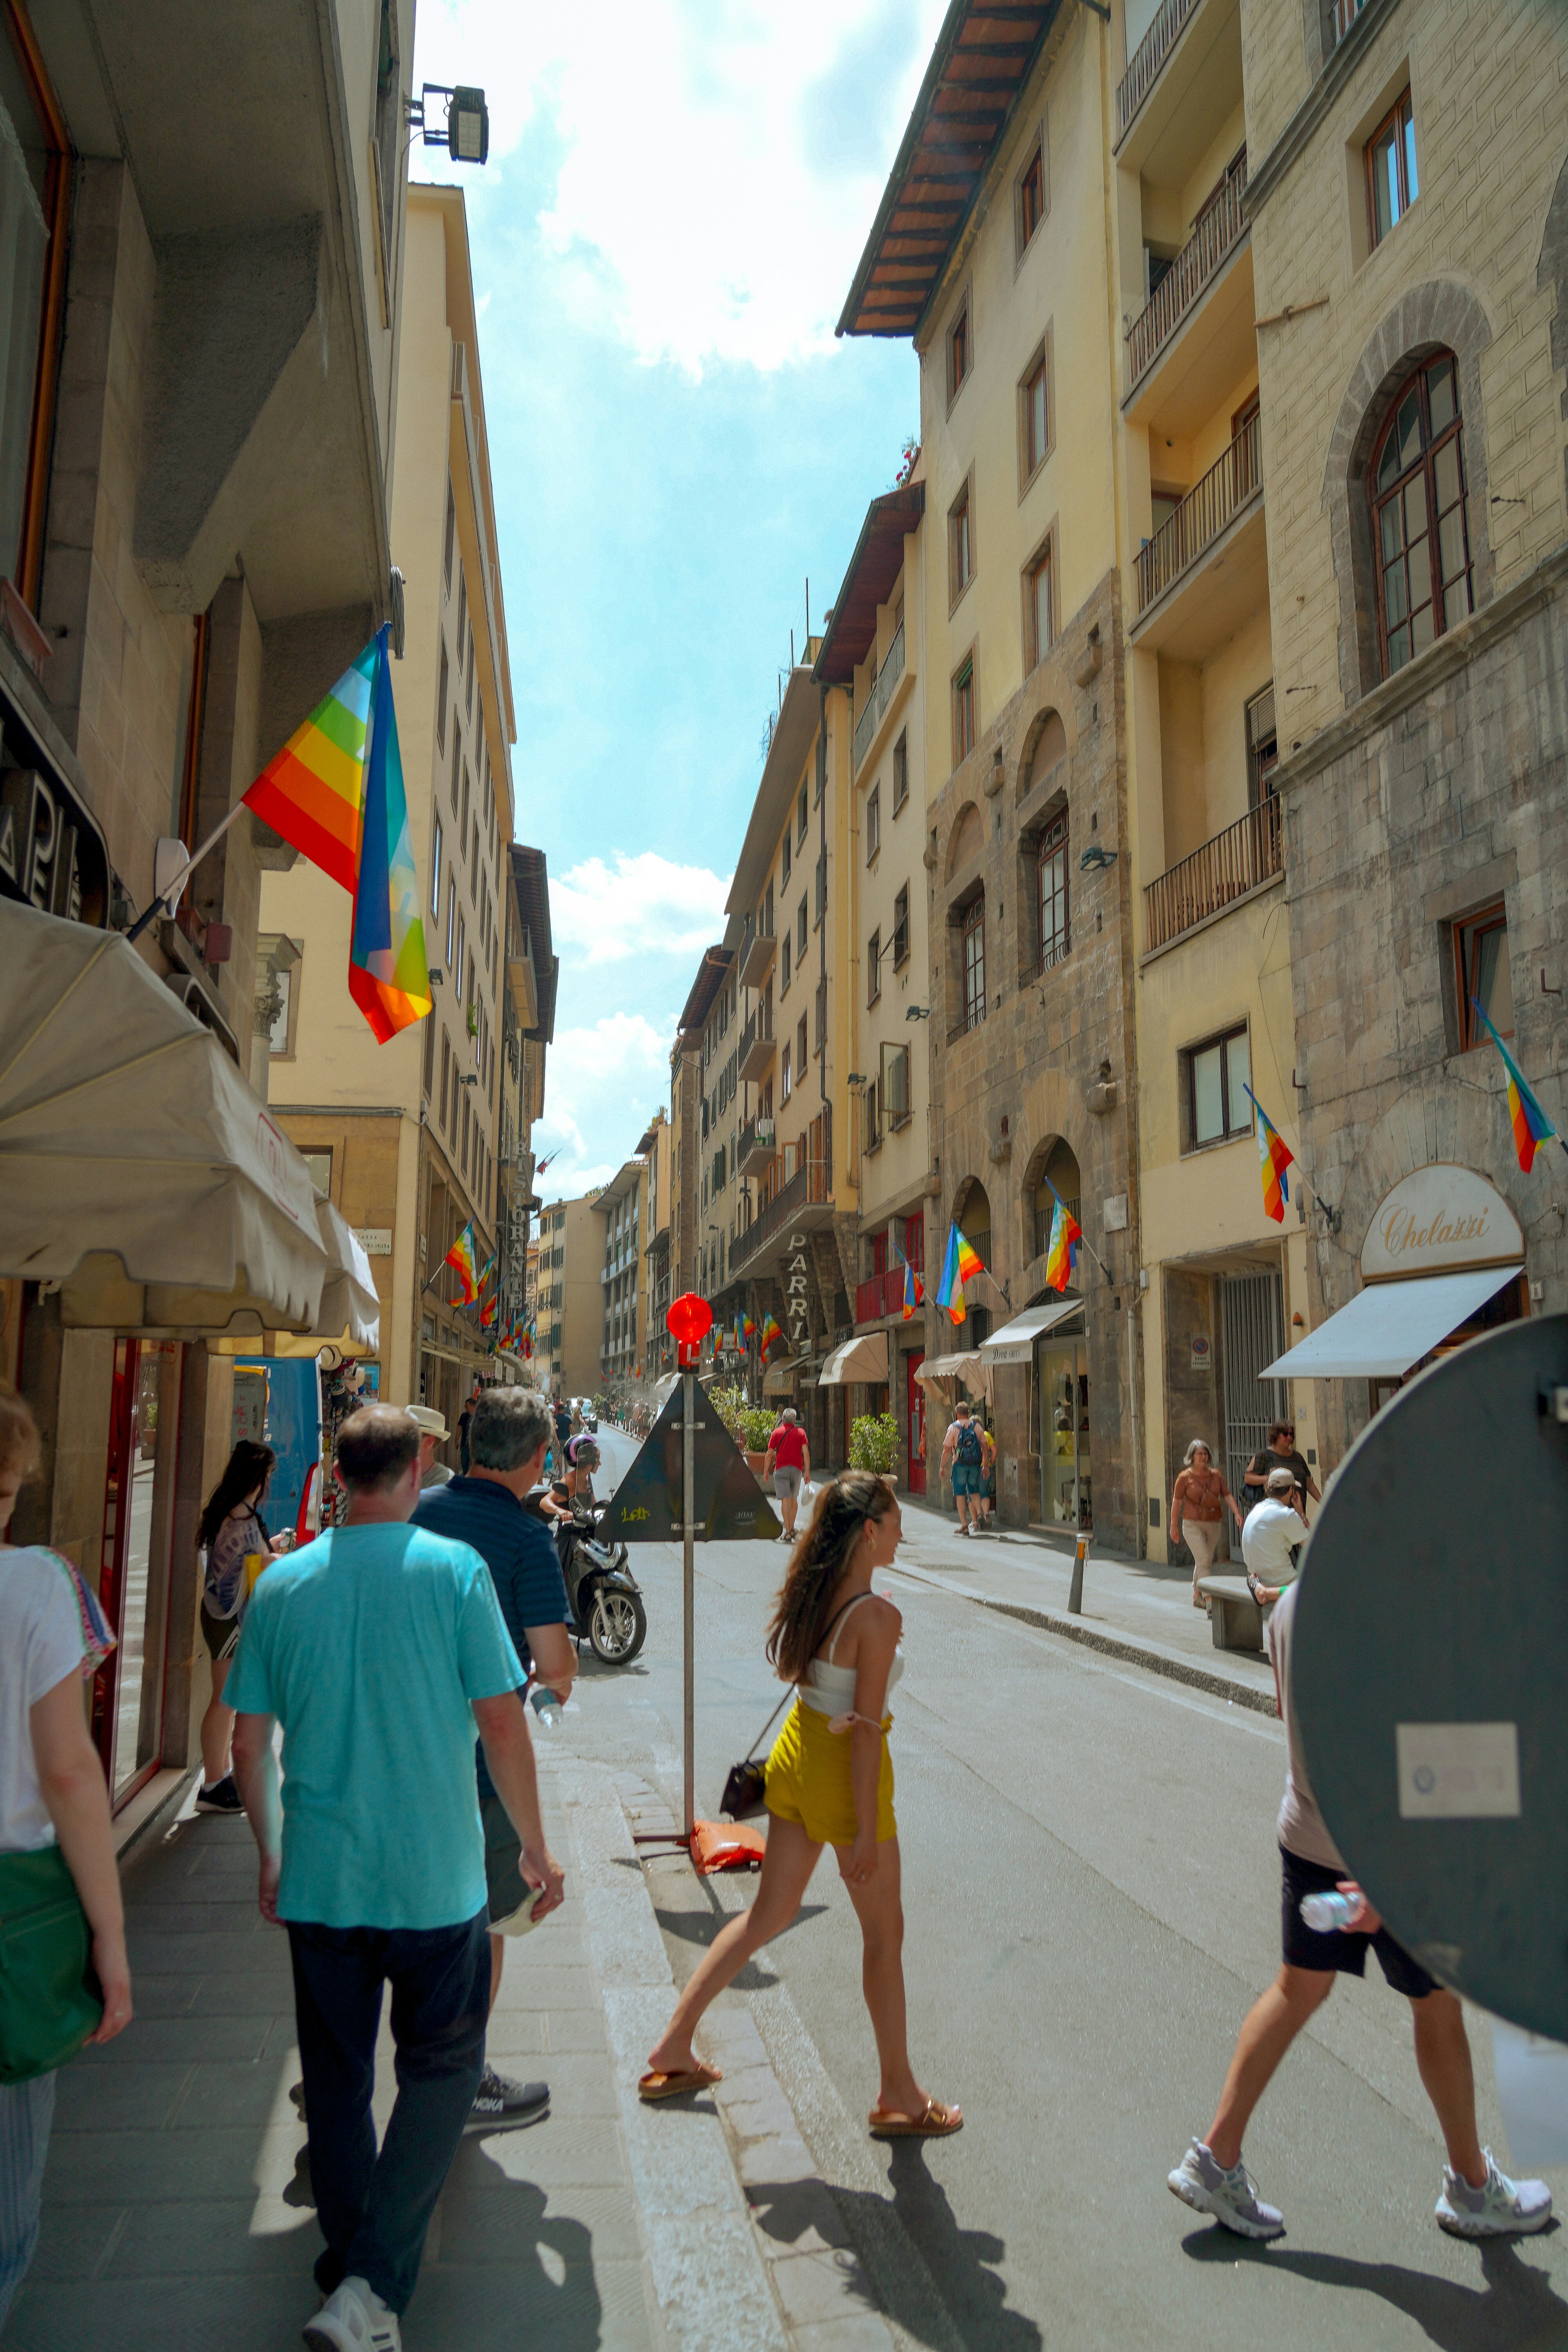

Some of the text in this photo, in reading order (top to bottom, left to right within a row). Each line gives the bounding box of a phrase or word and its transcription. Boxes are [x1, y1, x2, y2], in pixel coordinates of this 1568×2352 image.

[510, 1141, 527, 1309] RISTORANTE
[1379, 1203, 1490, 1258] Chelazzi
[787, 1234, 808, 1339] PARRI
[471, 2097, 504, 2112] HOKA
